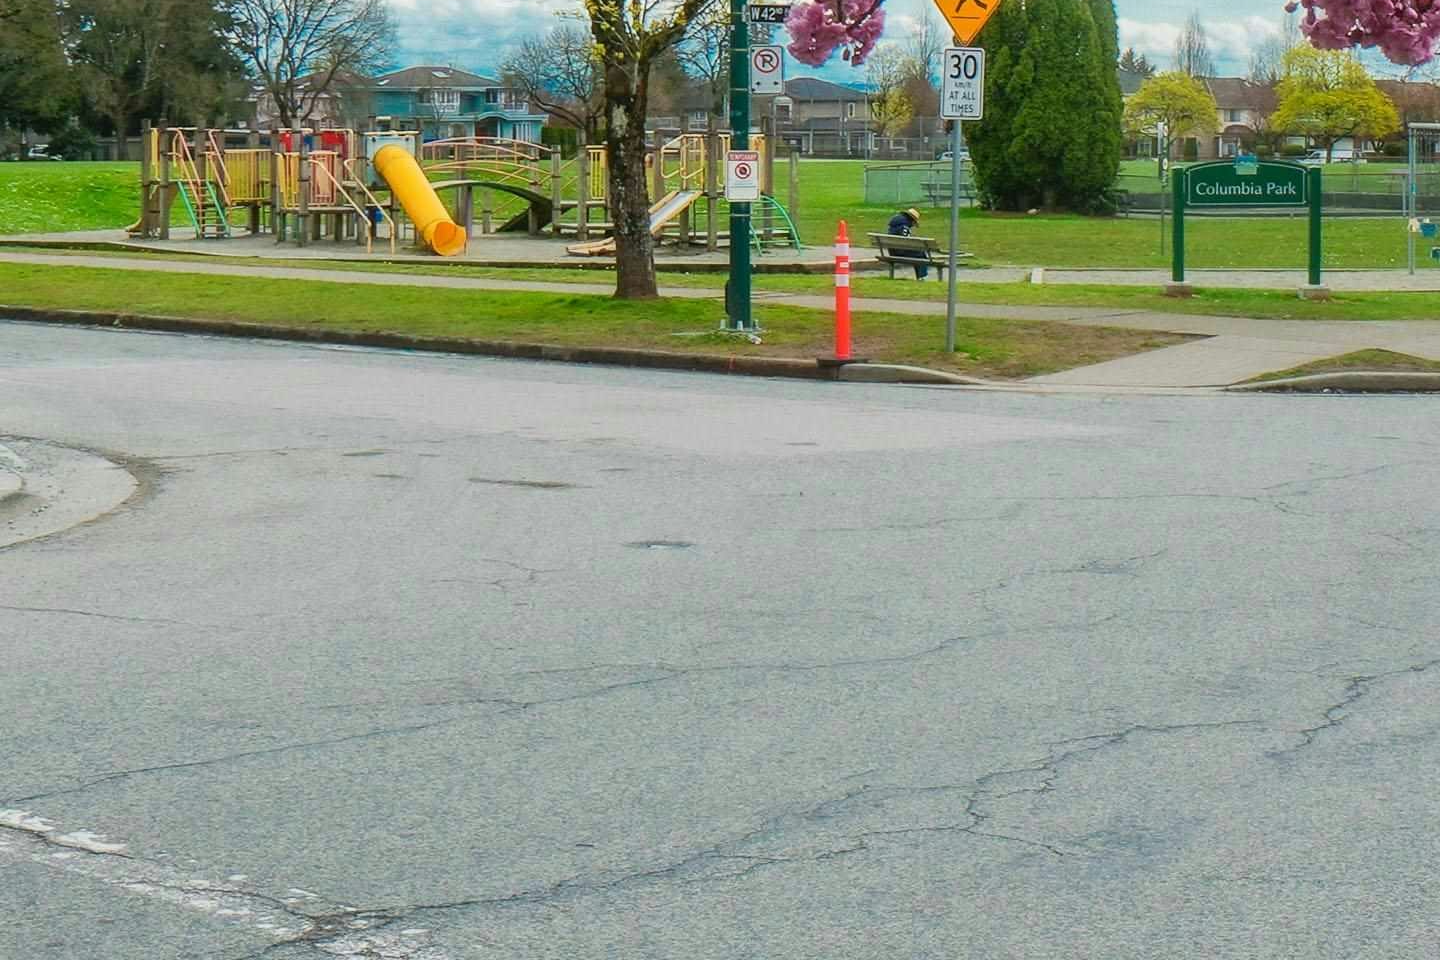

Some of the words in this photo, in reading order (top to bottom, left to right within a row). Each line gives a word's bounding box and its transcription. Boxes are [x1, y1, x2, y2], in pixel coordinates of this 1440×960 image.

[751, 6, 760, 20] W
[950, 54, 977, 79] 30
[949, 90, 959, 100] AT
[961, 90, 976, 101] ALL
[951, 103, 974, 113] TIMES
[1195, 182, 1262, 196] Columbia
[1266, 182, 1297, 195] Park
